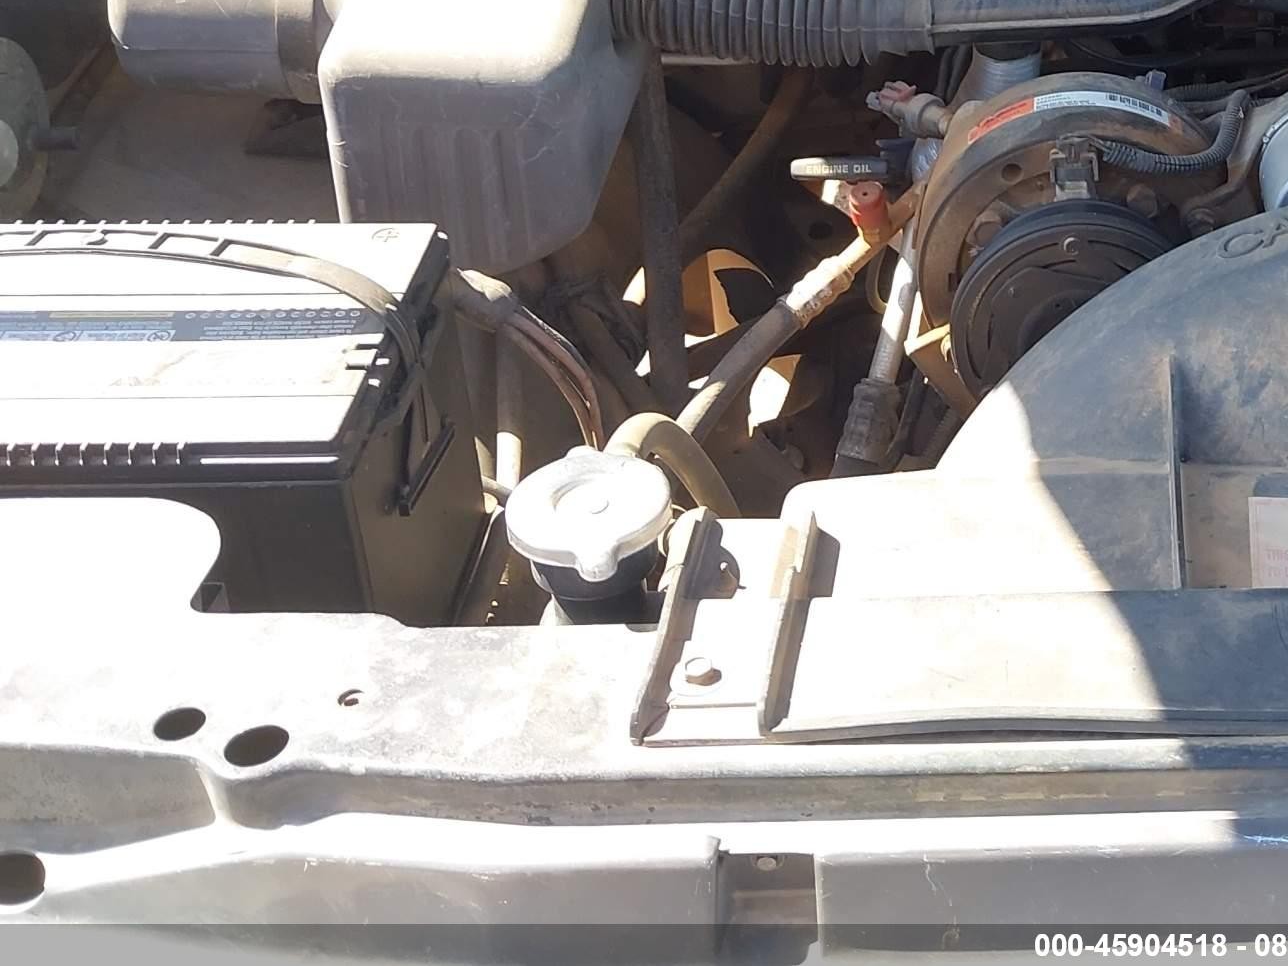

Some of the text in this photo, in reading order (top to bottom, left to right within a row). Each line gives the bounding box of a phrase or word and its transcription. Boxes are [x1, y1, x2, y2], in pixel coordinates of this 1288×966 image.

[806, 164, 872, 174] ENGINE OIL
[1267, 566, 1282, 578] TO
